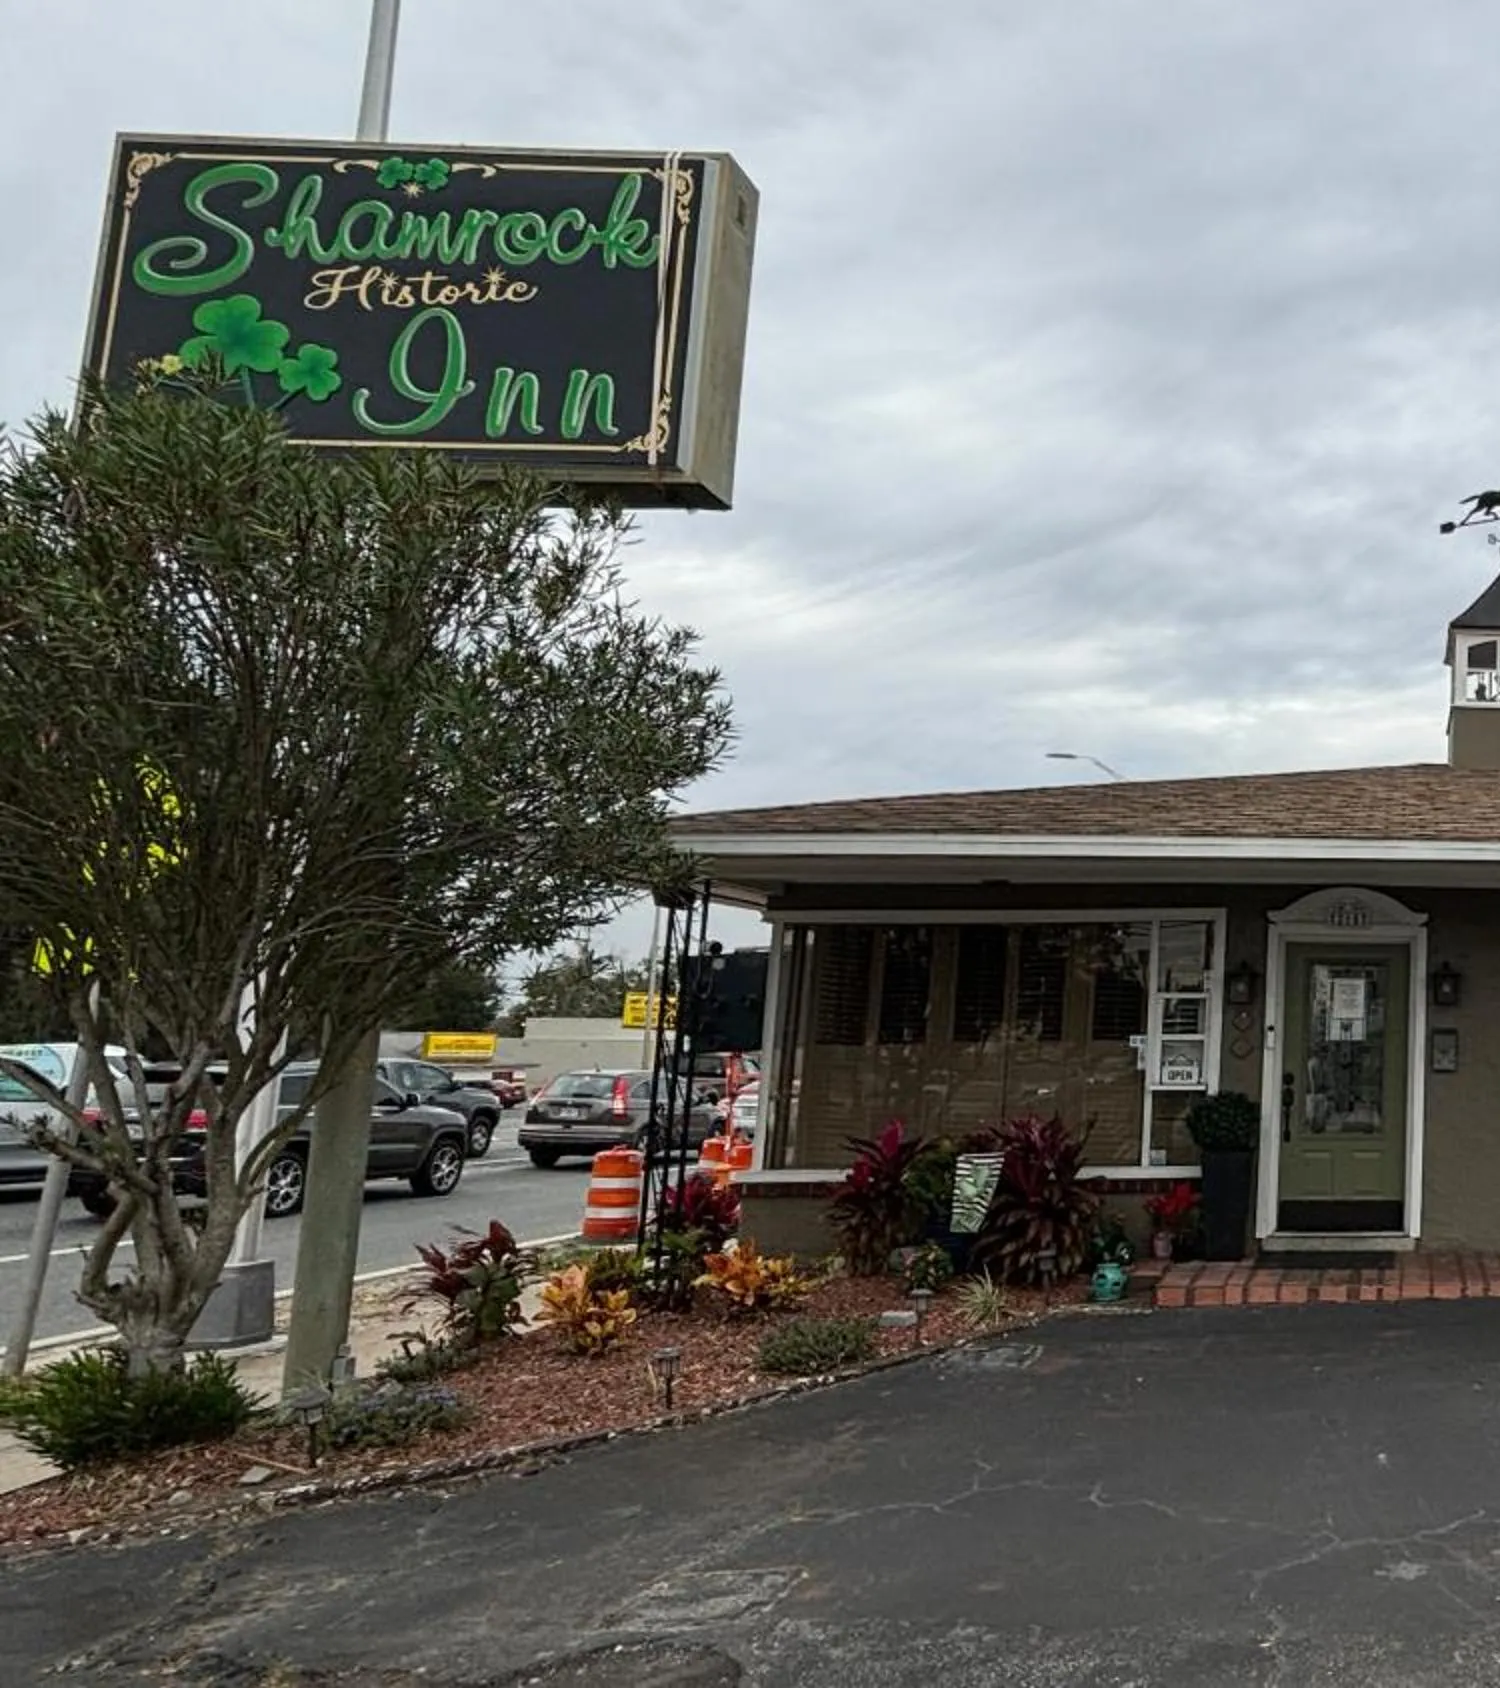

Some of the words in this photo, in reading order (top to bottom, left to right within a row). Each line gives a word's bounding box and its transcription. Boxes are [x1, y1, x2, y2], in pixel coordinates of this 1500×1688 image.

[133, 162, 661, 296] Shamrock
[303, 265, 539, 311] Historic
[352, 307, 620, 439] Inn
[1167, 1069, 1193, 1081] OPEN
